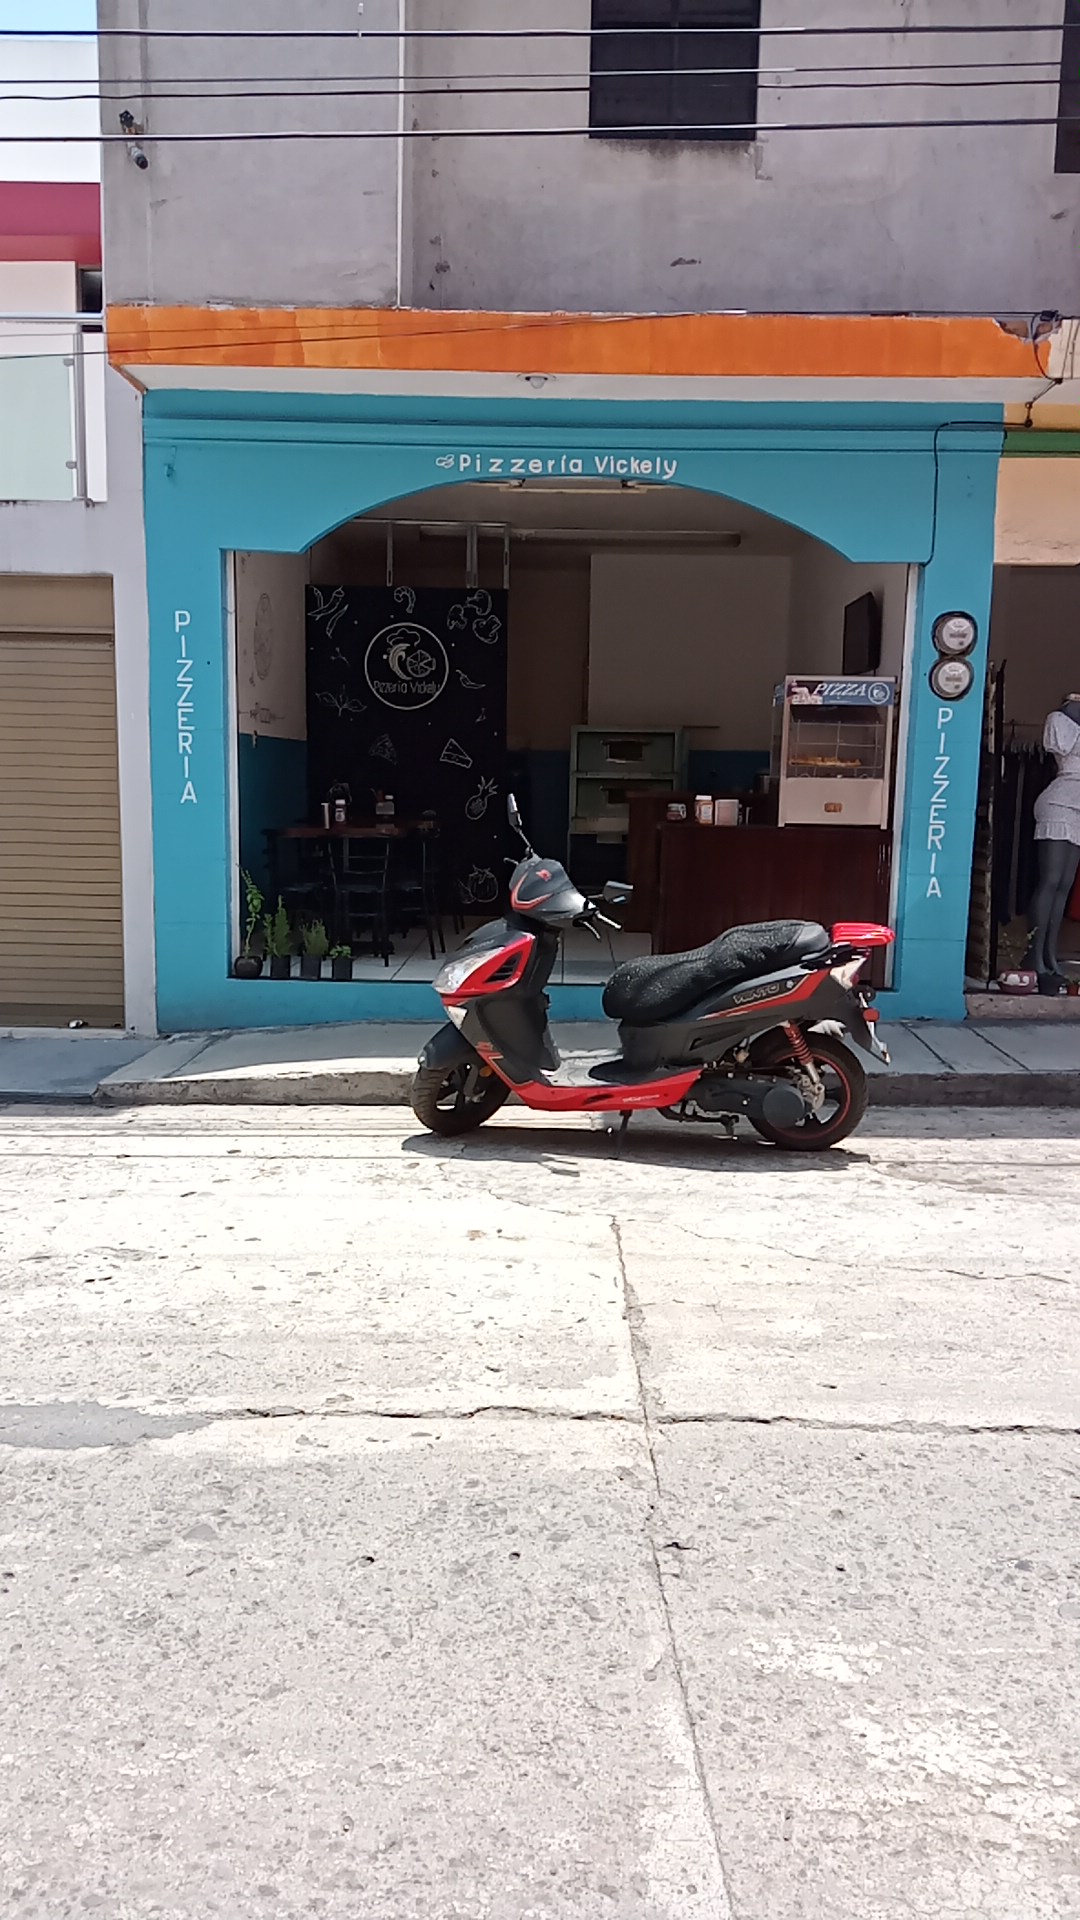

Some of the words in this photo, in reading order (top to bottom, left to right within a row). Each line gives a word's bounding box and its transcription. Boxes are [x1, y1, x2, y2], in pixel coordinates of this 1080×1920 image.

[594, 455, 678, 479] Vickely
[174, 610, 198, 804] PIZZERIA
[813, 682, 867, 697] PIZZA
[925, 706, 954, 899] PIZZERIA
